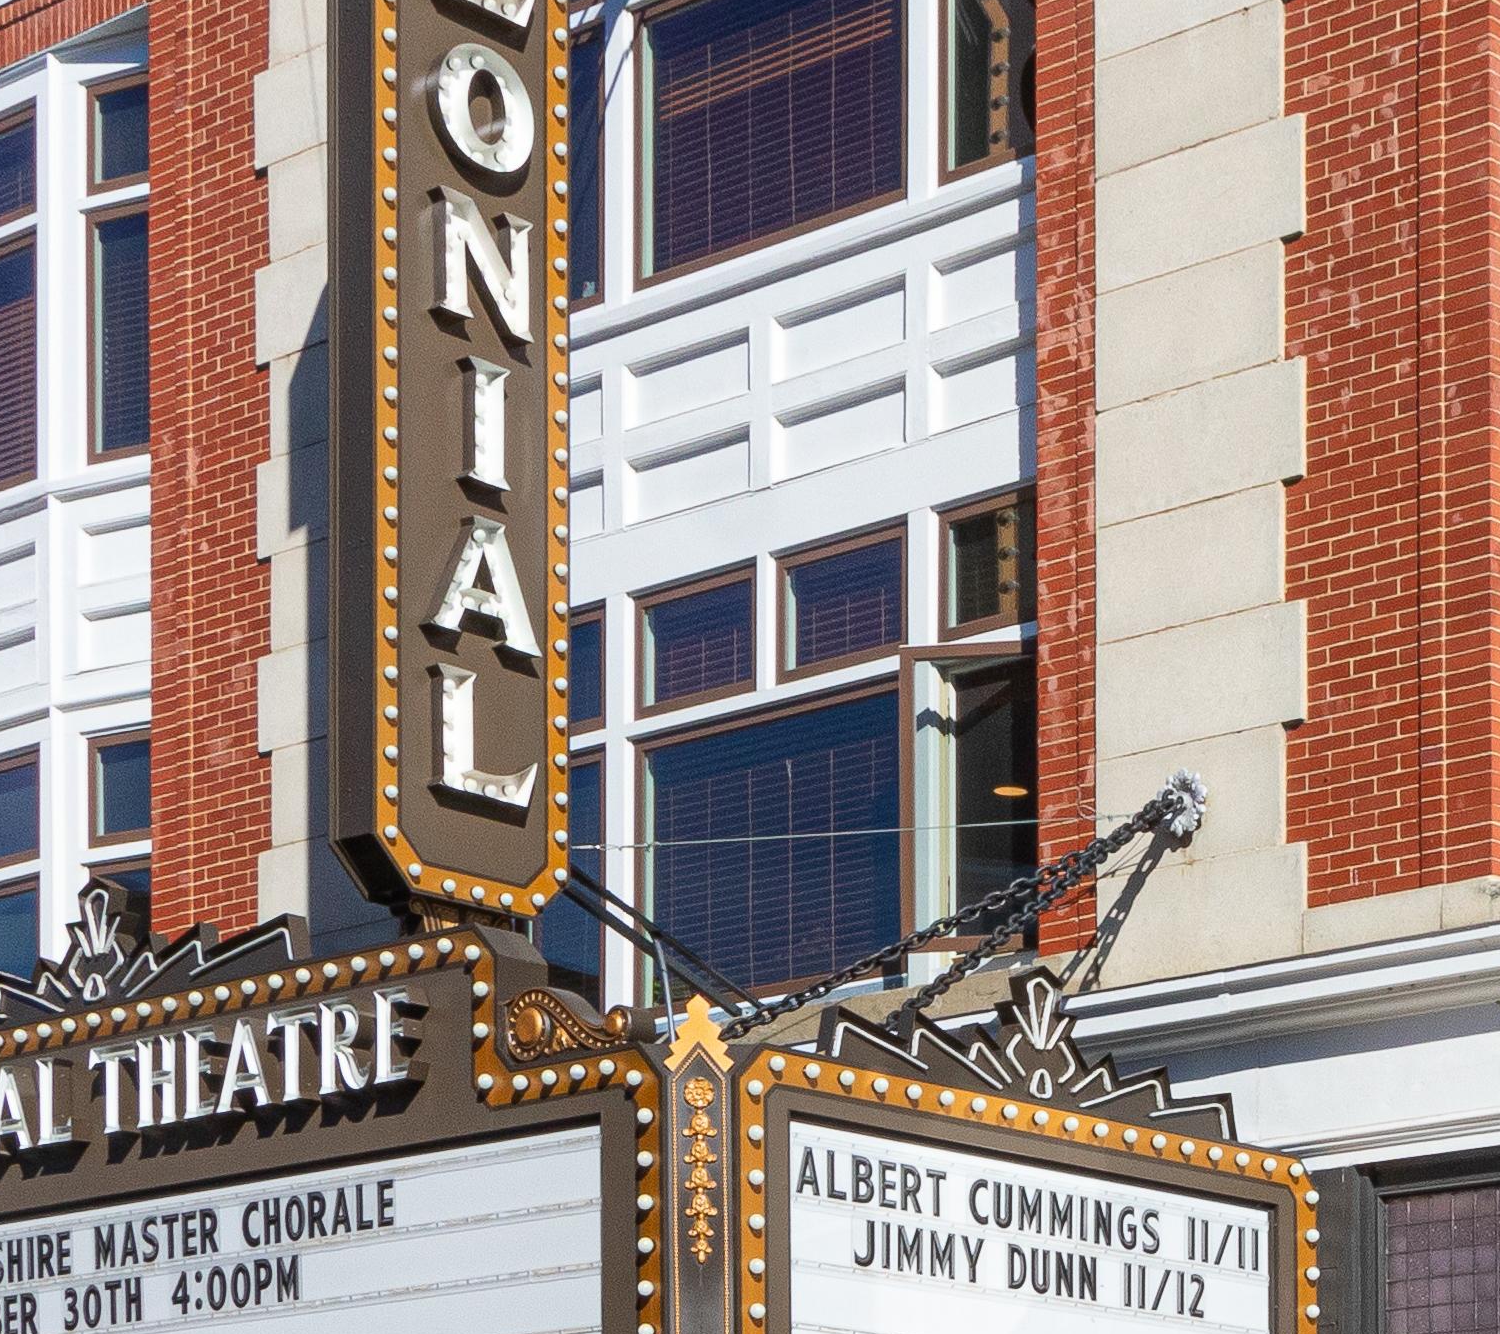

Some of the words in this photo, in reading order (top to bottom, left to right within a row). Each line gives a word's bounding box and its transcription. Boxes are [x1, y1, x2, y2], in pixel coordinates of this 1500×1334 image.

[88, 987, 414, 1135] THEATRE
[94, 1208, 219, 1269] MASTER
[241, 1180, 396, 1247] CHORALE
[796, 1146, 947, 1218] ALBERT
[969, 1178, 1162, 1255] CUMMINGS
[1187, 1216, 1260, 1272] 11/11
[63, 1279, 144, 1332] 30TH
[171, 1255, 301, 1316] 4:00PM
[853, 1220, 985, 1283] JIMMY
[1008, 1244, 1098, 1302] DUNN
[1124, 1263, 1206, 1319] 11/12
